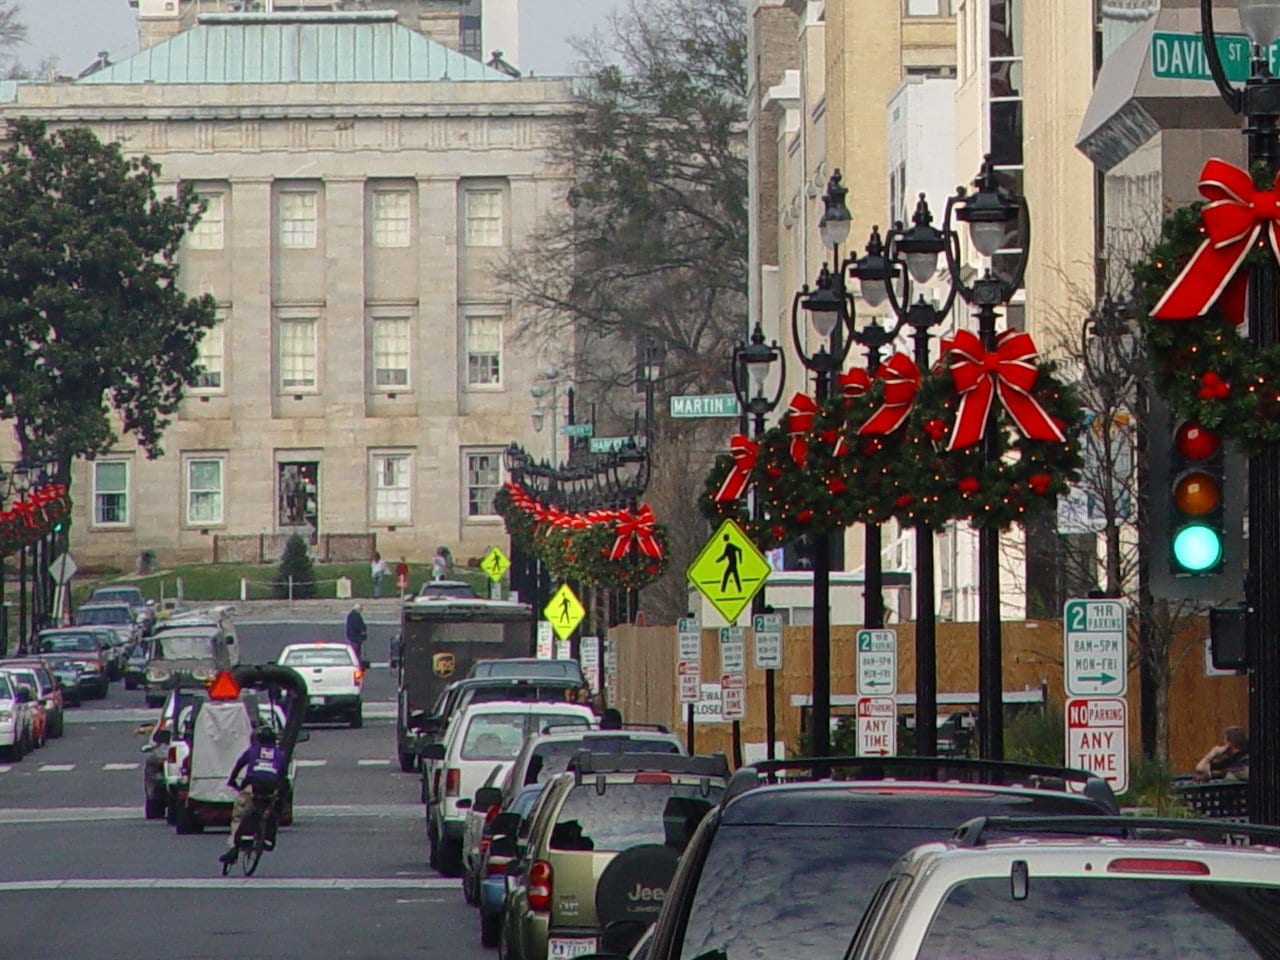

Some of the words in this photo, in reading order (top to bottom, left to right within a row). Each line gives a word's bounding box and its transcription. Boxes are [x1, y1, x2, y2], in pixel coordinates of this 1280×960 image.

[1228, 43, 1241, 61] ST
[674, 398, 724, 414] MARTIN
[1072, 606, 1085, 630] 2
[1095, 605, 1113, 617] HR
[1088, 618, 1122, 630] PARKING
[861, 634, 870, 650] 2
[1074, 640, 1118, 653] 8AM-5PM
[1076, 658, 1117, 671] MON-FRI
[1070, 705, 1087, 725] NO
[1089, 708, 1122, 721] PARKING
[865, 720, 887, 732] ANY
[864, 735, 888, 747] TIME
[1080, 731, 1114, 750] ANY
[1078, 753, 1116, 772] TIME
[628, 884, 667, 902] Jee
